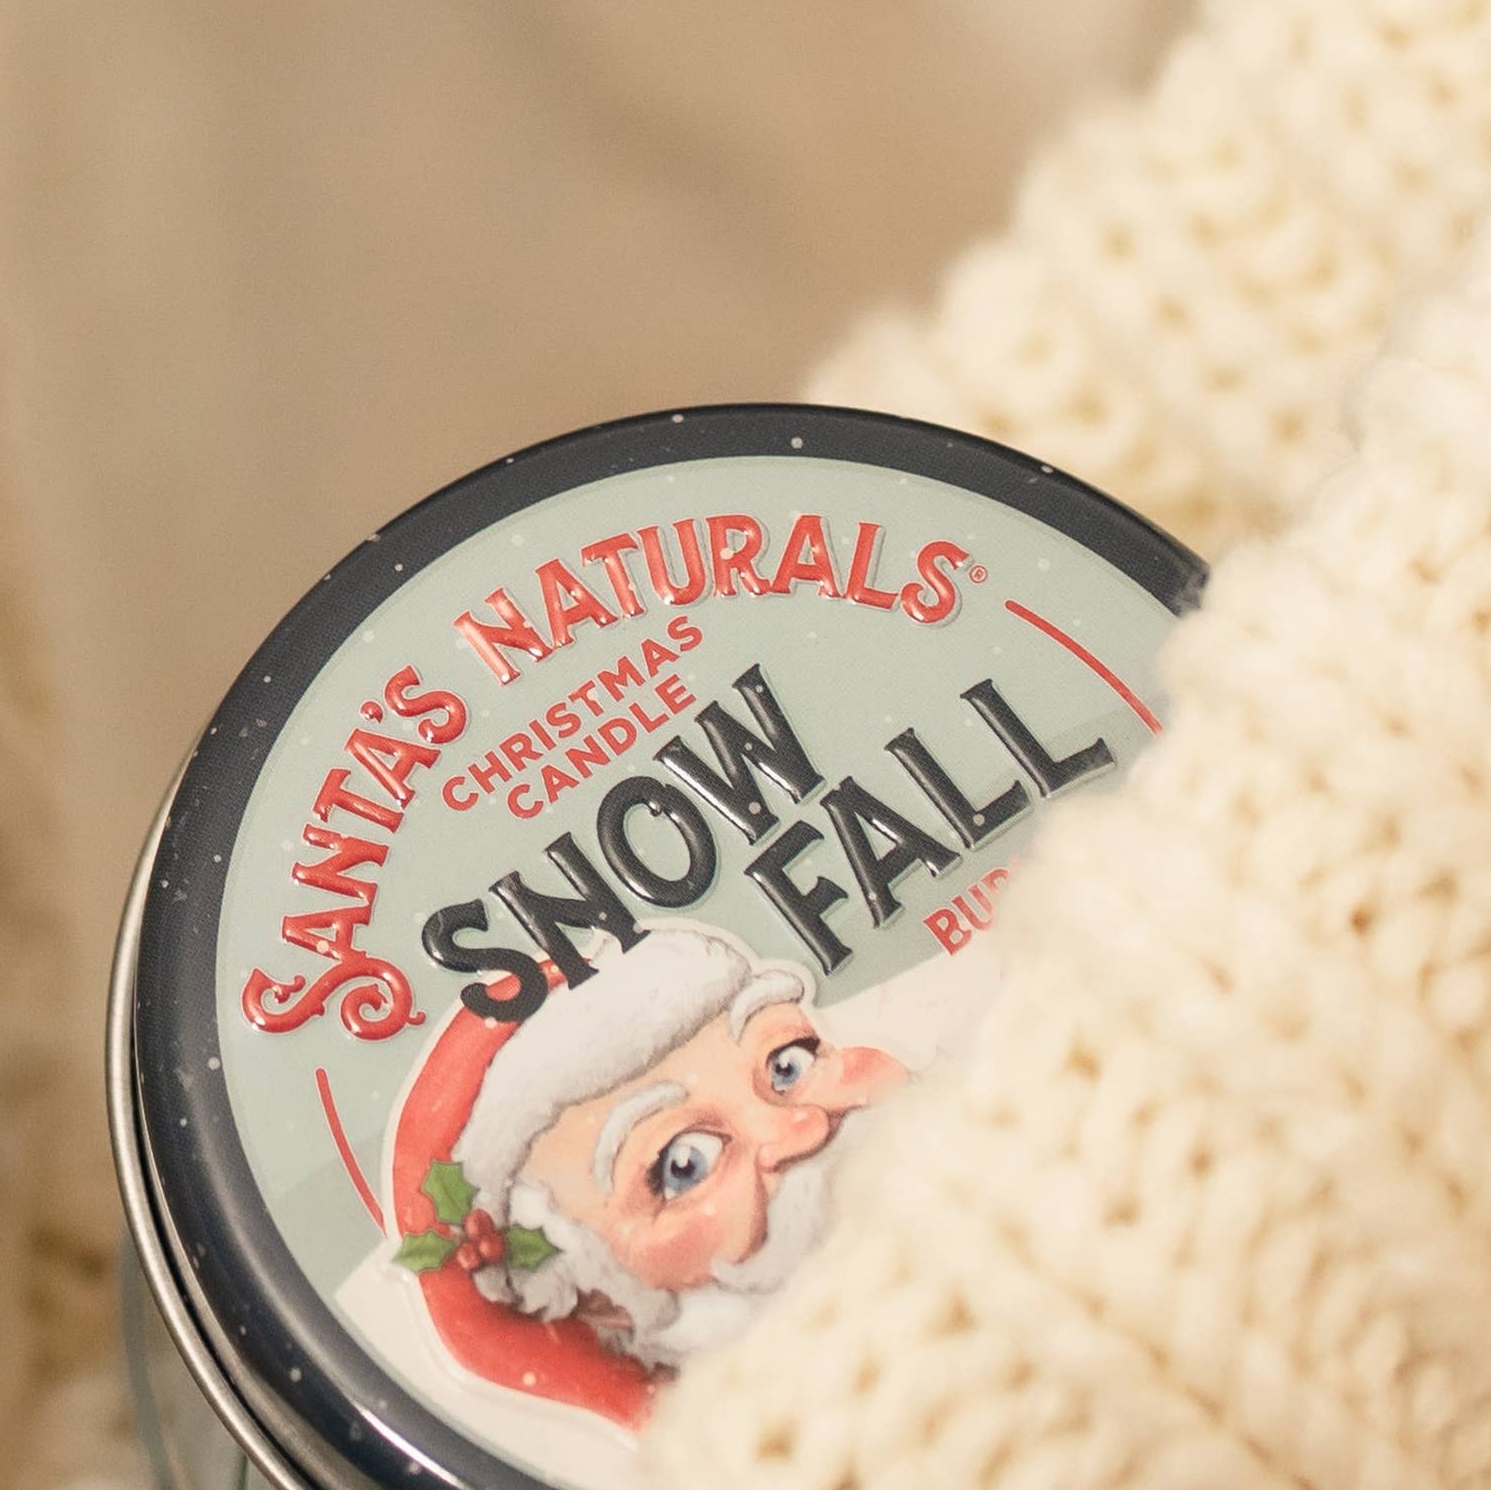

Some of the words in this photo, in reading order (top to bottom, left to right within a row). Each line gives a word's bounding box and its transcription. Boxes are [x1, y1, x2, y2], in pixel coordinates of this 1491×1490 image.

[241, 664, 469, 1043] SANTA'S
[420, 663, 826, 1025] SNOW
[439, 615, 705, 814] CHRISTMAS
[505, 675, 697, 821] CANDLE
[747, 677, 1117, 978] FALL
